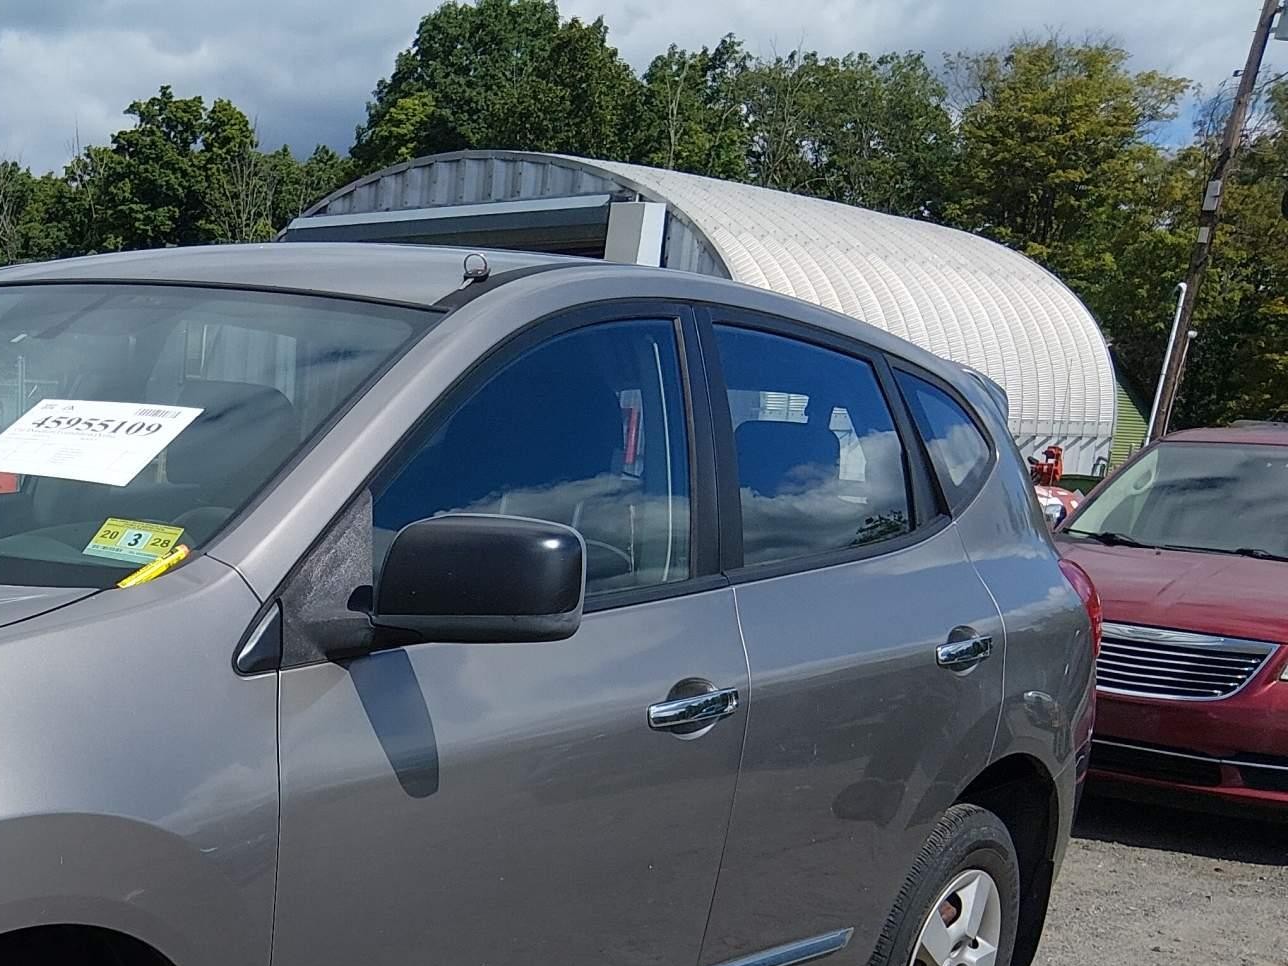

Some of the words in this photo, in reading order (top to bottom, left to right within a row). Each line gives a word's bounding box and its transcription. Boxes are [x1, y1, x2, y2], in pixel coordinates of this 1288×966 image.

[31, 415, 163, 436] 45955109
[99, 529, 120, 540] 20
[127, 533, 143, 547] 3
[150, 537, 172, 548] 28
